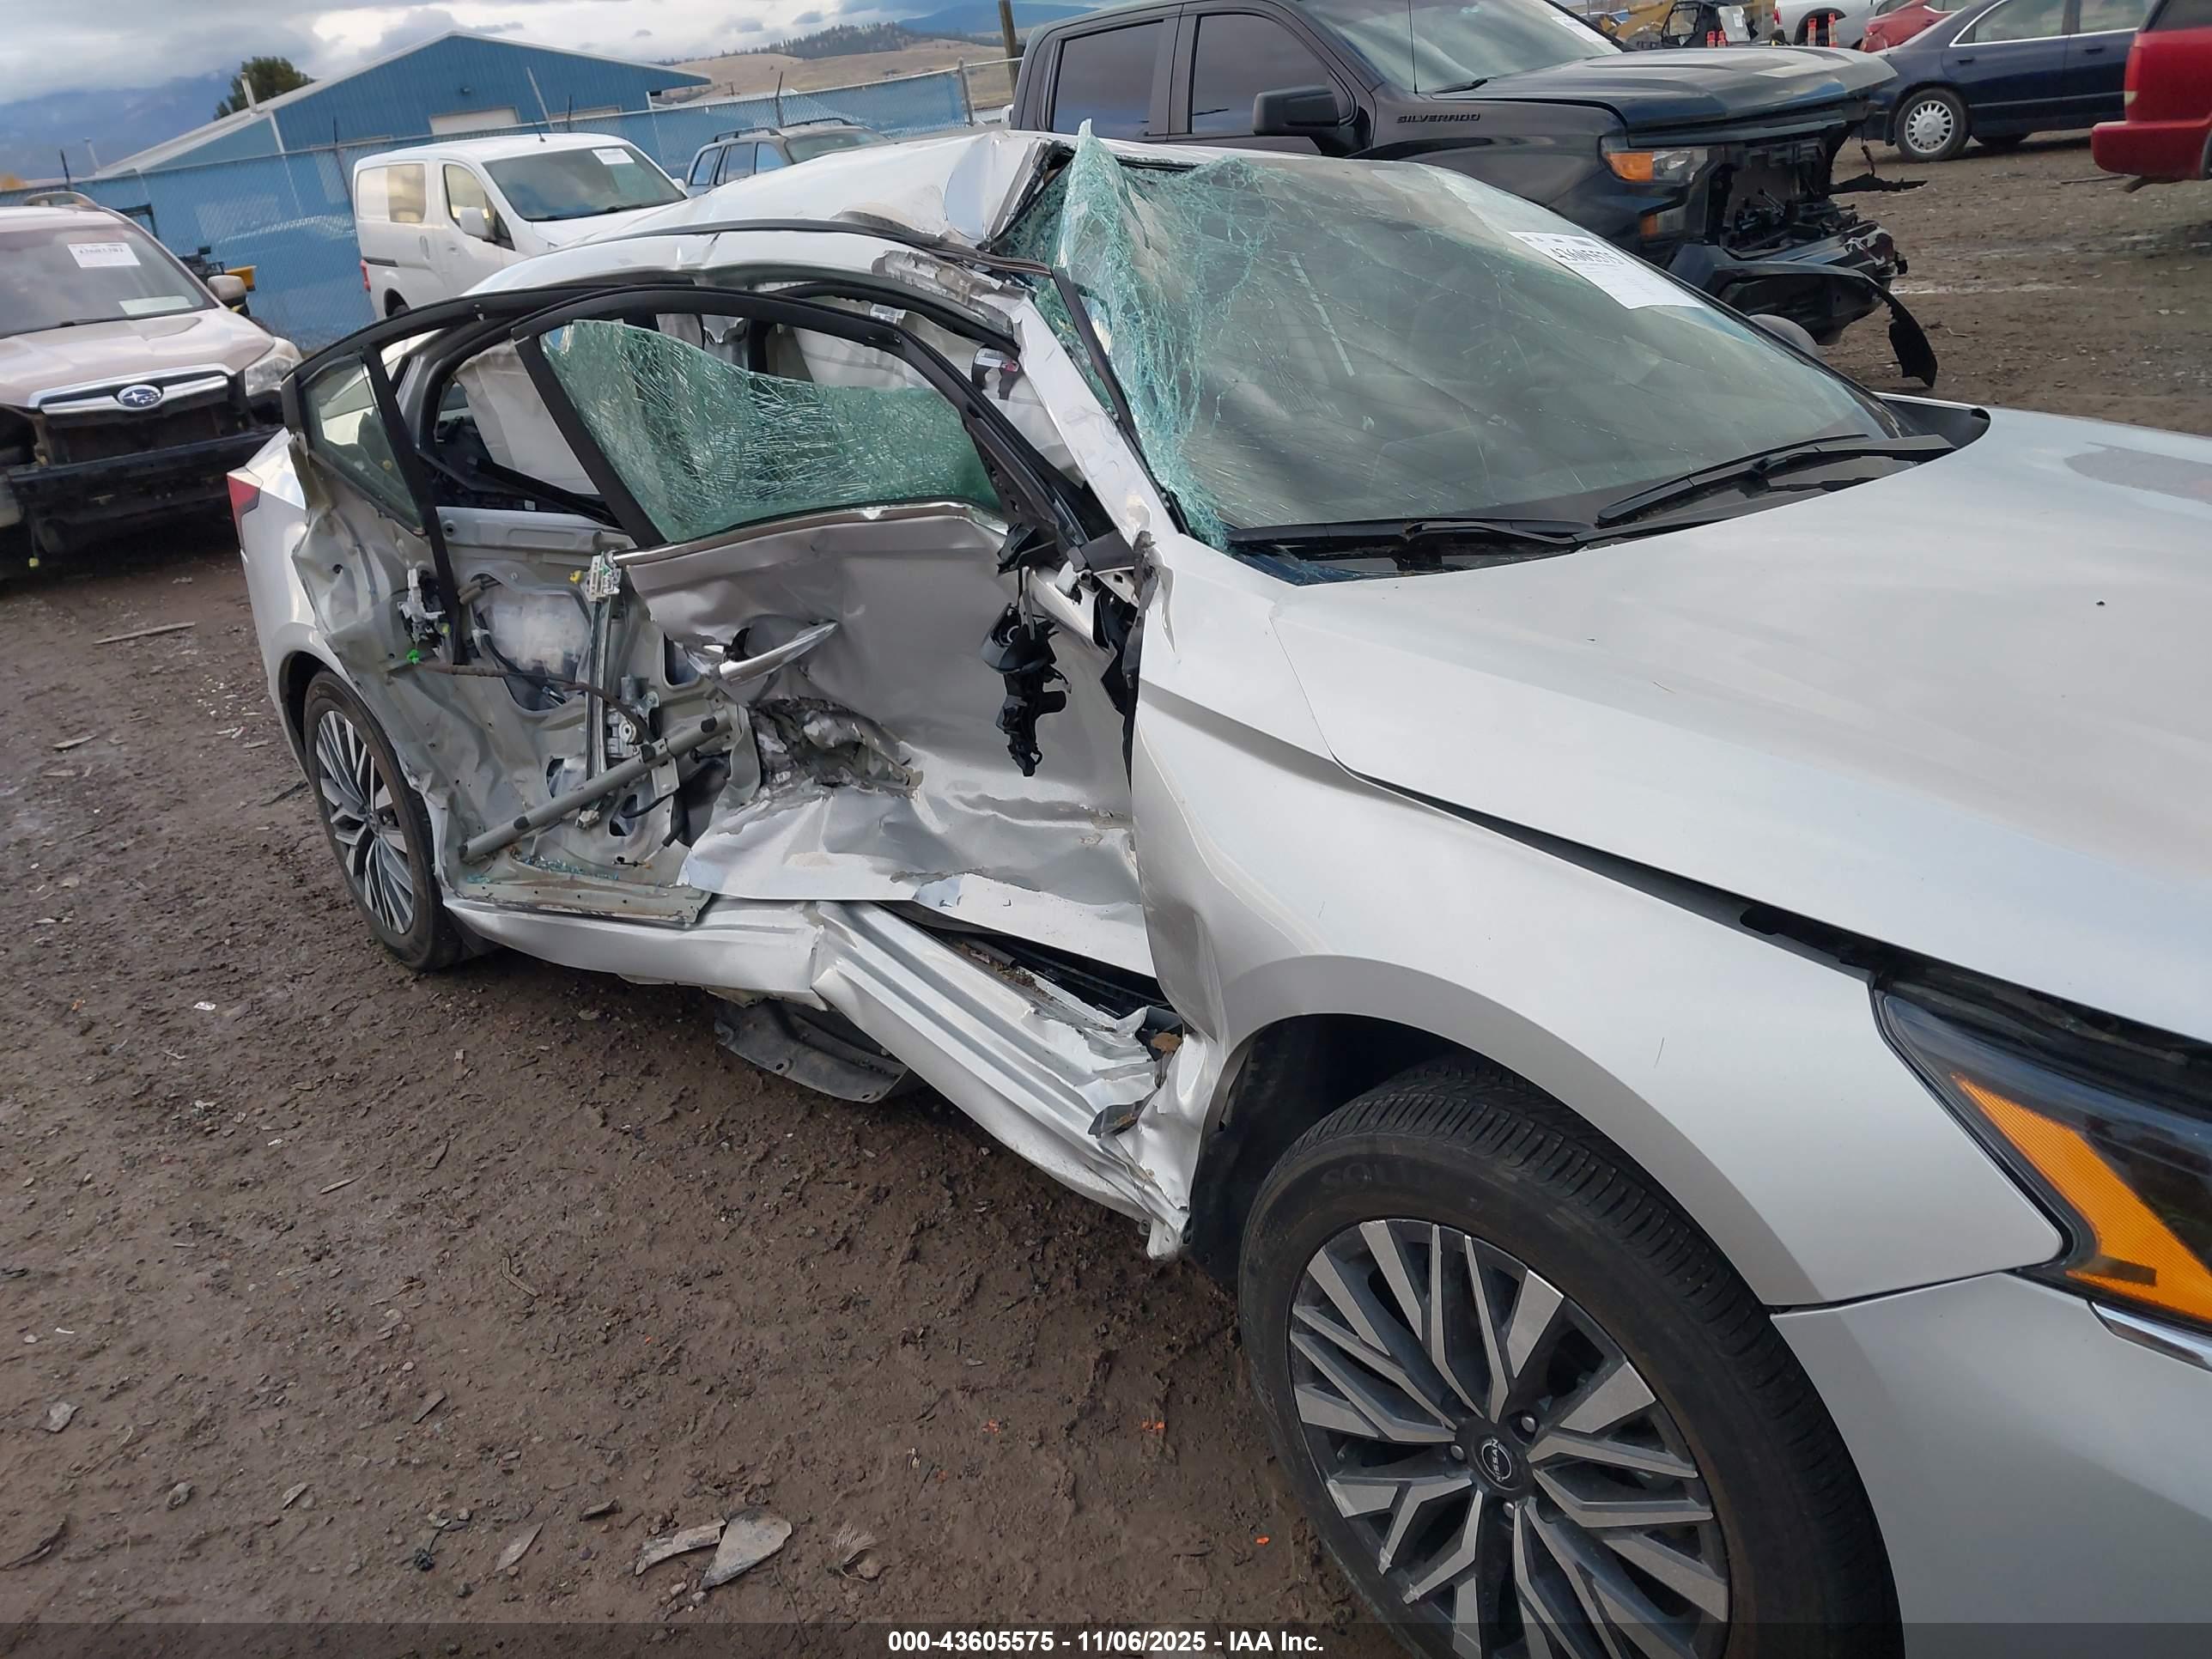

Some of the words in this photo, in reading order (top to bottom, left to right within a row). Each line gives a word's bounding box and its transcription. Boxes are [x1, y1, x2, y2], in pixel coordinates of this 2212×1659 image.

[1396, 113, 1481, 124] SILVERADO
[1551, 246, 1625, 265] 43605575
[1491, 1437, 1504, 1483] NISSAN
